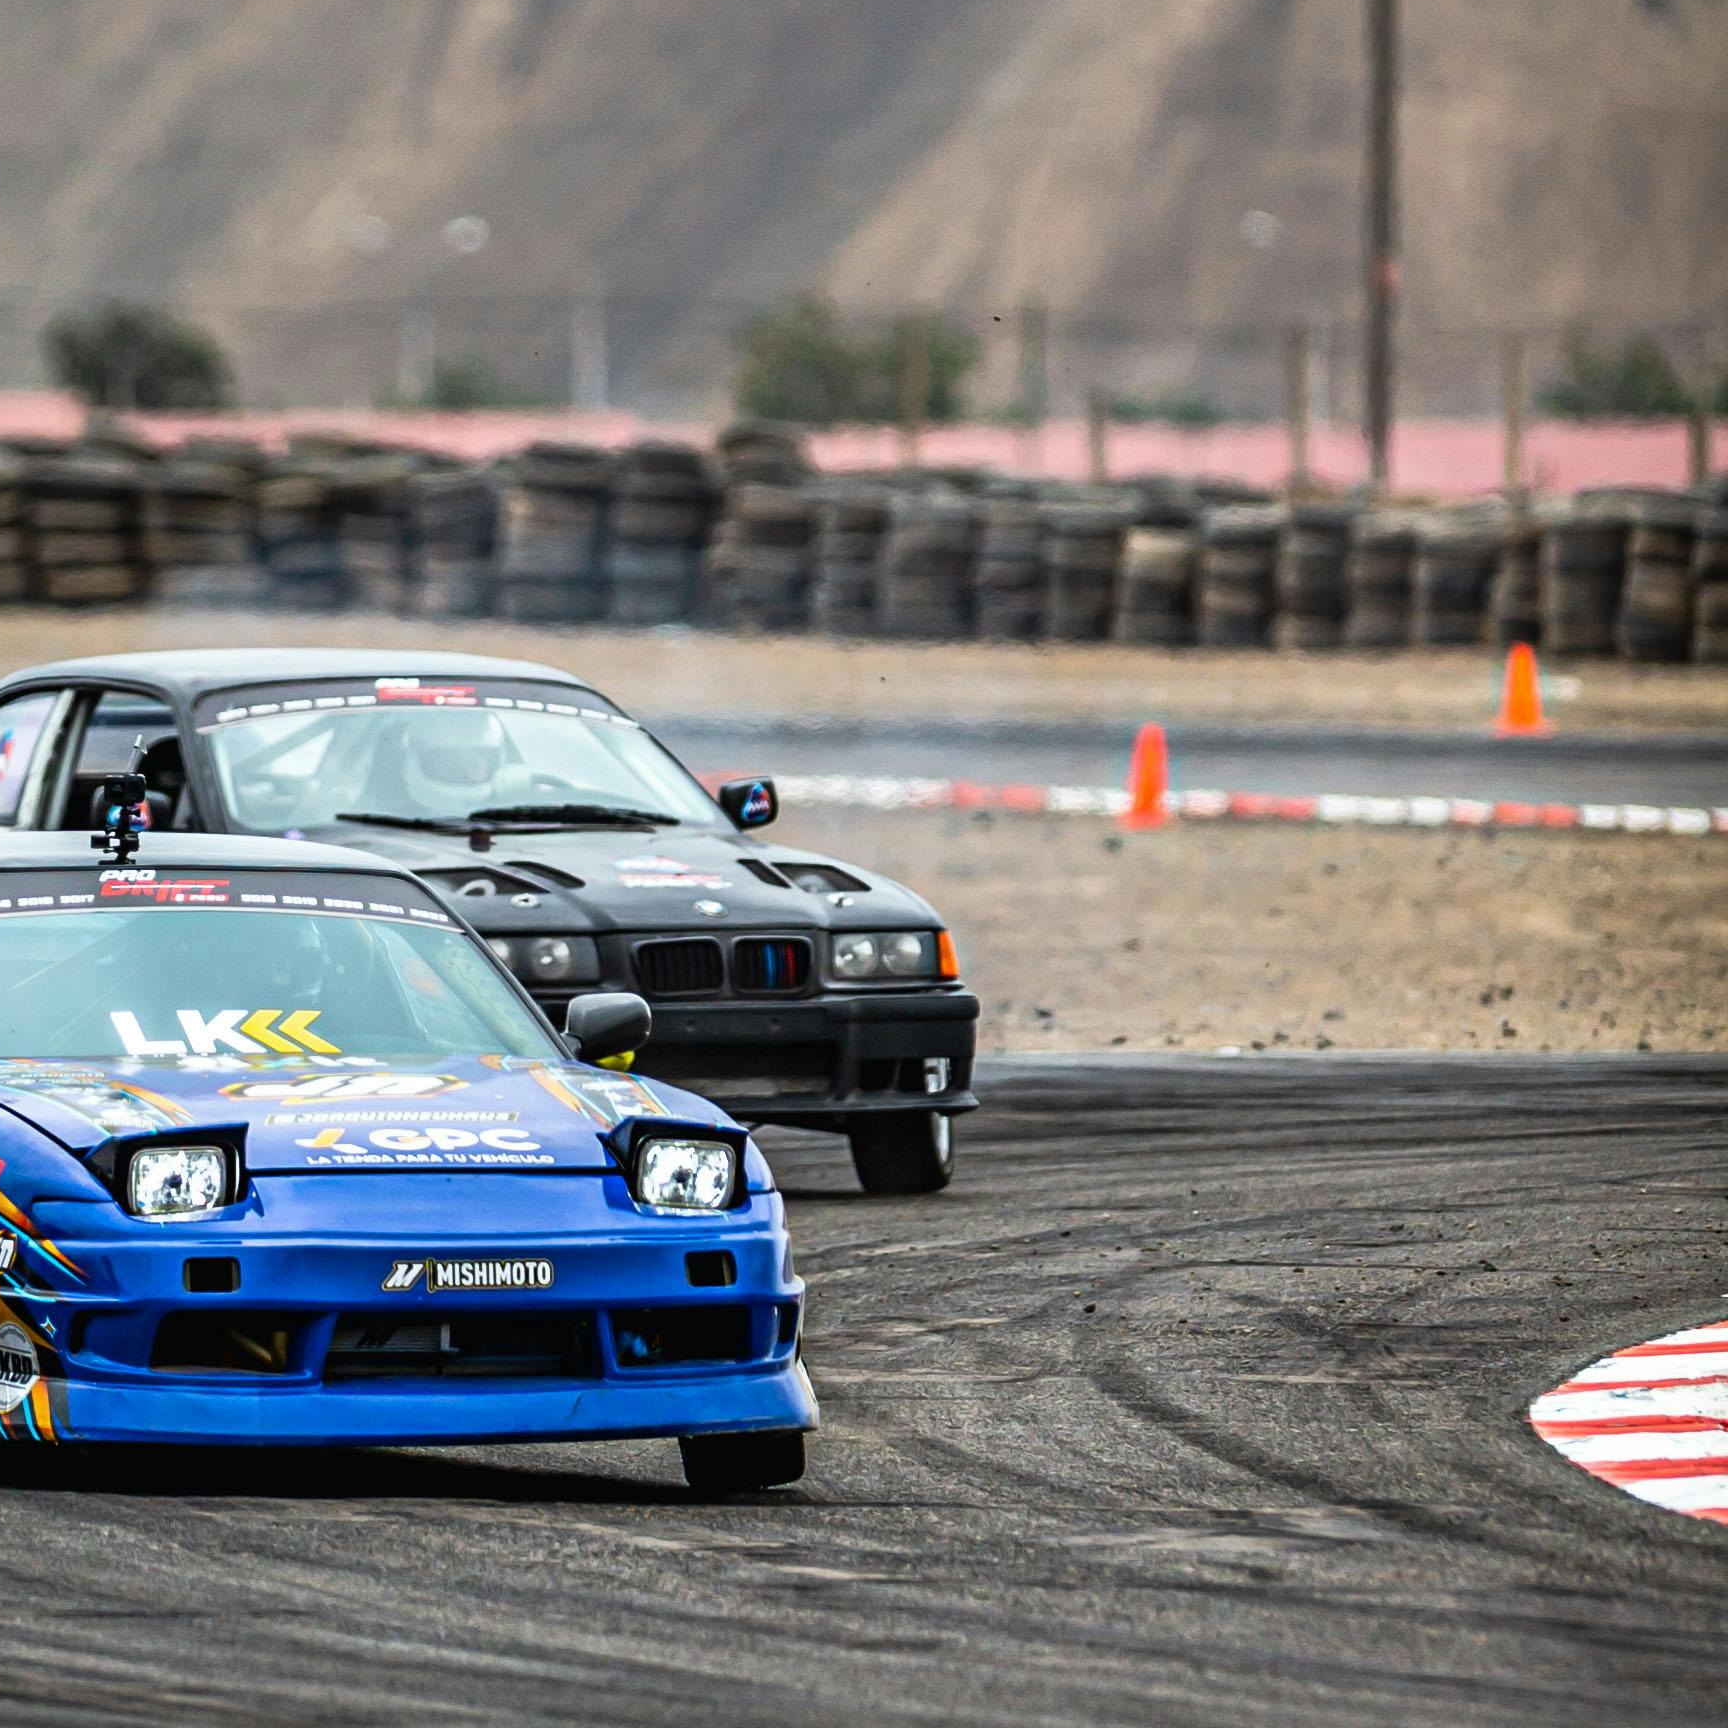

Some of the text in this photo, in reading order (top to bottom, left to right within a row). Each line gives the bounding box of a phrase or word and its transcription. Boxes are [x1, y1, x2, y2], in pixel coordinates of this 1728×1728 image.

[99, 869, 157, 882] PRO
[100, 880, 230, 903] DRIFT
[369, 1128, 542, 1150] GPC
[307, 1155, 332, 1165] LA
[333, 1154, 395, 1165] TIENDA
[396, 1153, 443, 1164] PARA
[444, 1153, 467, 1164] TU
[436, 1261, 551, 1286] MISHIMOTO
